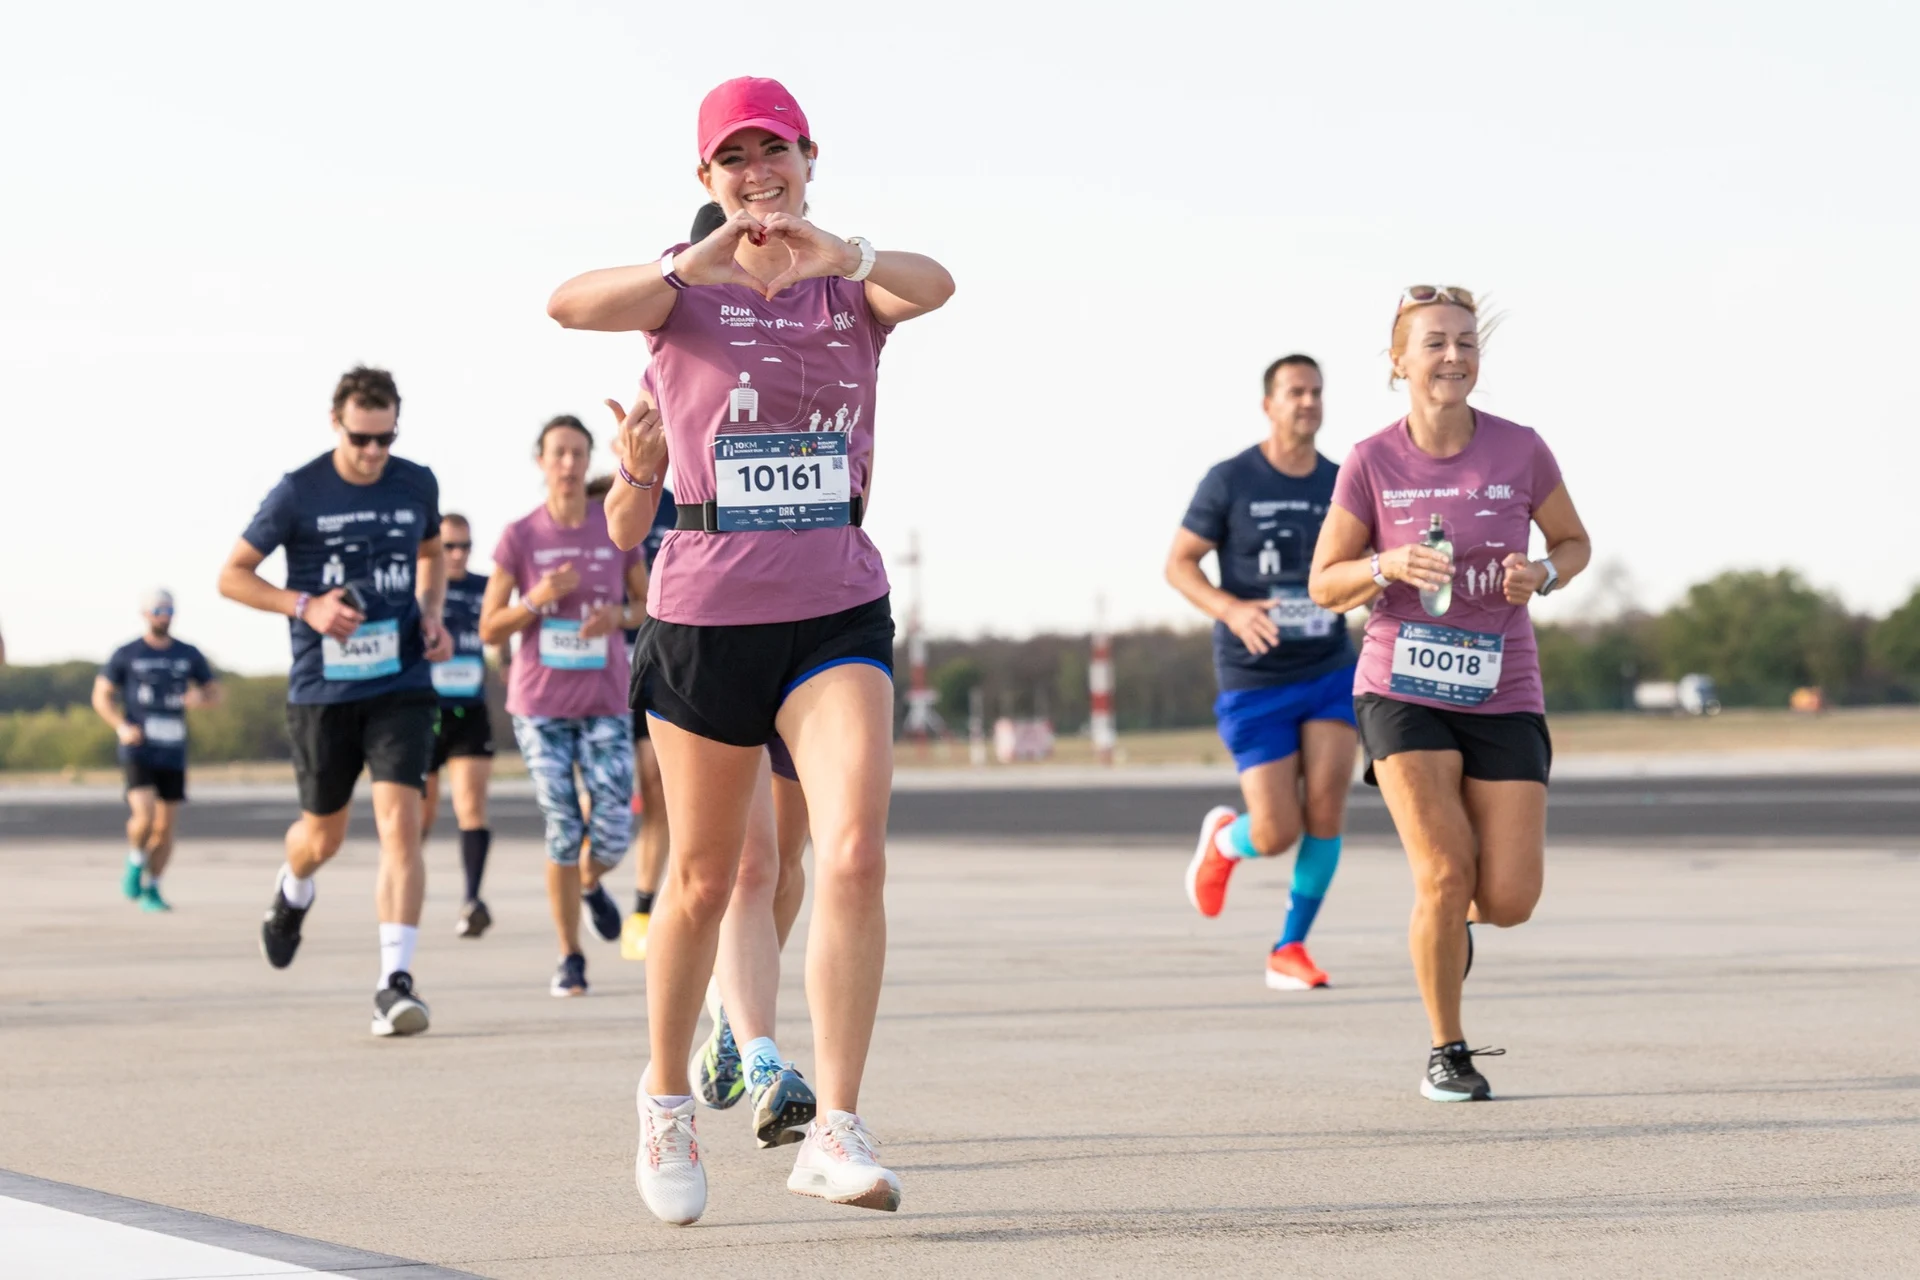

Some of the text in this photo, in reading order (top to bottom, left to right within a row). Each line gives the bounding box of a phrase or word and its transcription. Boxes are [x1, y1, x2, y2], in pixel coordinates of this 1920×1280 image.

[734, 441, 758, 449] 10KM
[737, 463, 821, 492] 10161
[1382, 488, 1433, 500] RUNWAY
[1433, 487, 1460, 498] RUN
[1407, 646, 1481, 676] 10018
